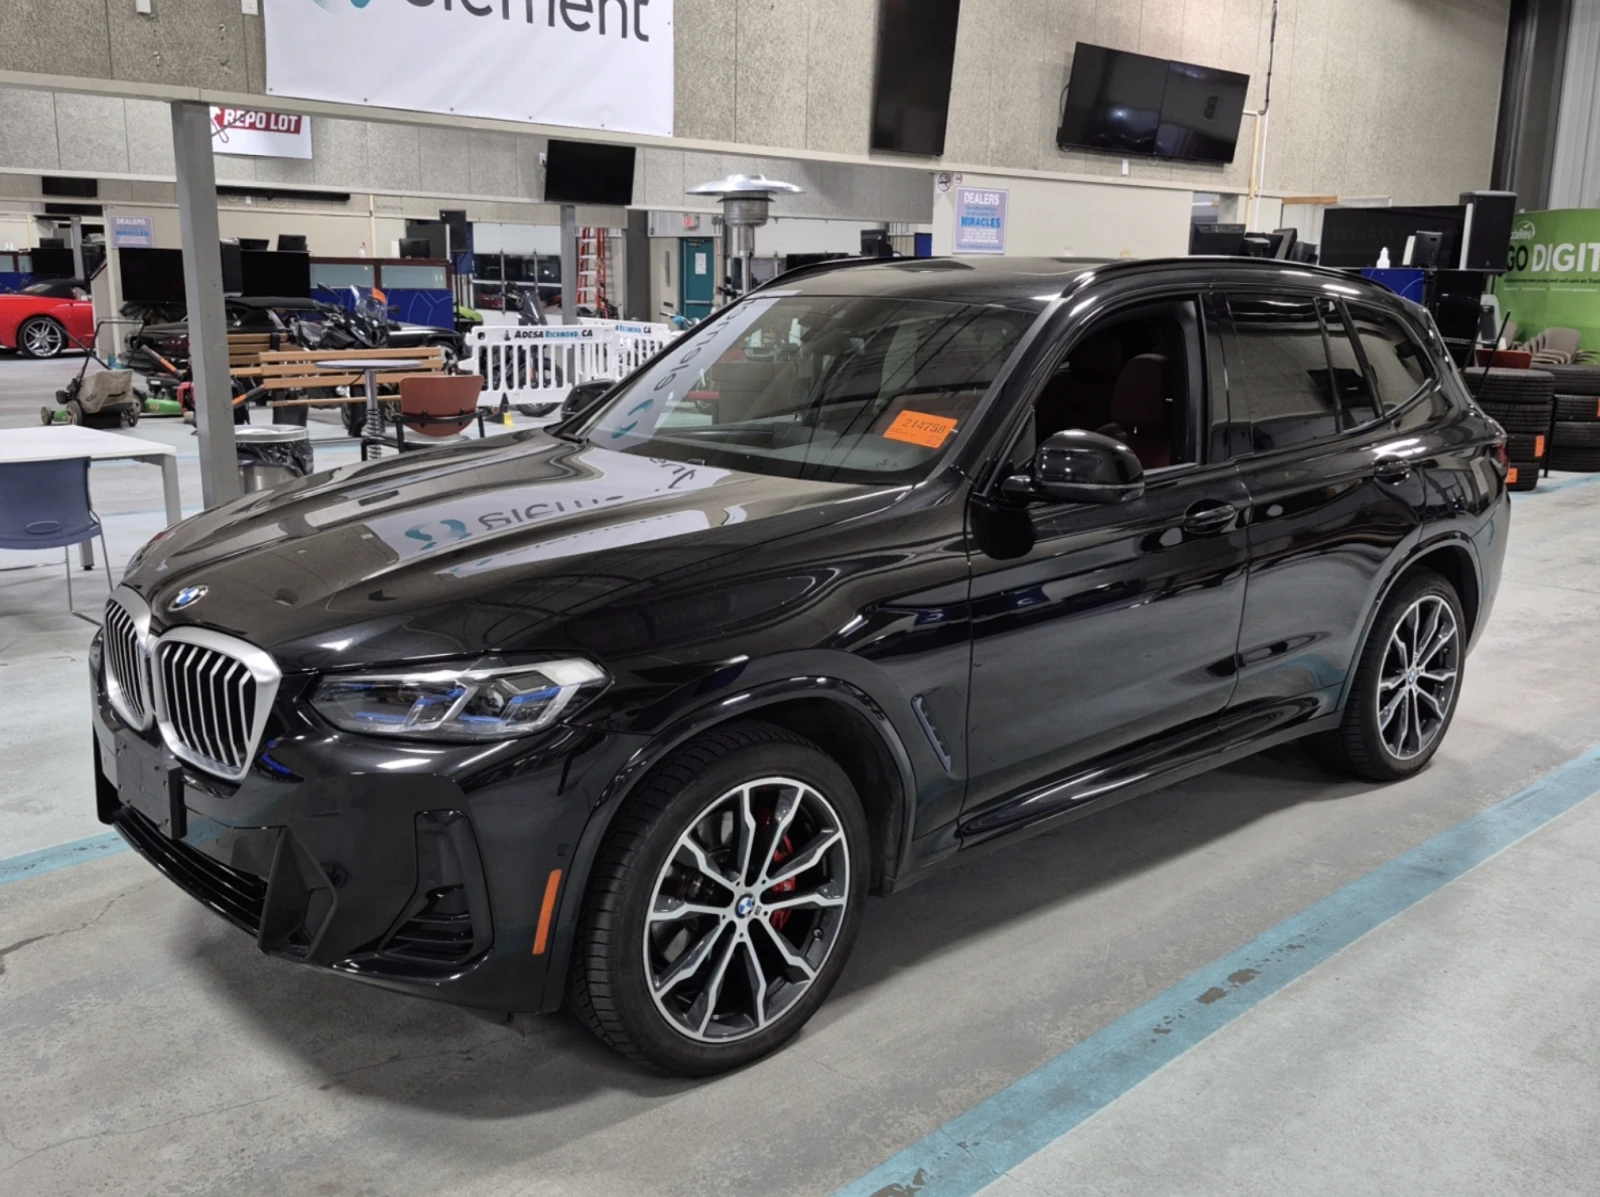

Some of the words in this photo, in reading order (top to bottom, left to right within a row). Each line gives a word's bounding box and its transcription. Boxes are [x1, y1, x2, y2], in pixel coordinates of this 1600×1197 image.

[405, 0, 649, 42] ment
[223, 108, 267, 129] REPO
[269, 113, 299, 133] LOT
[963, 191, 1000, 206] DEALERS
[115, 217, 146, 226] DEALERS
[960, 215, 1001, 229] MIRACLES
[1506, 244, 1529, 272] GO
[581, 328, 593, 338] CA
[643, 326, 652, 334] CA
[901, 417, 947, 435] 214758
